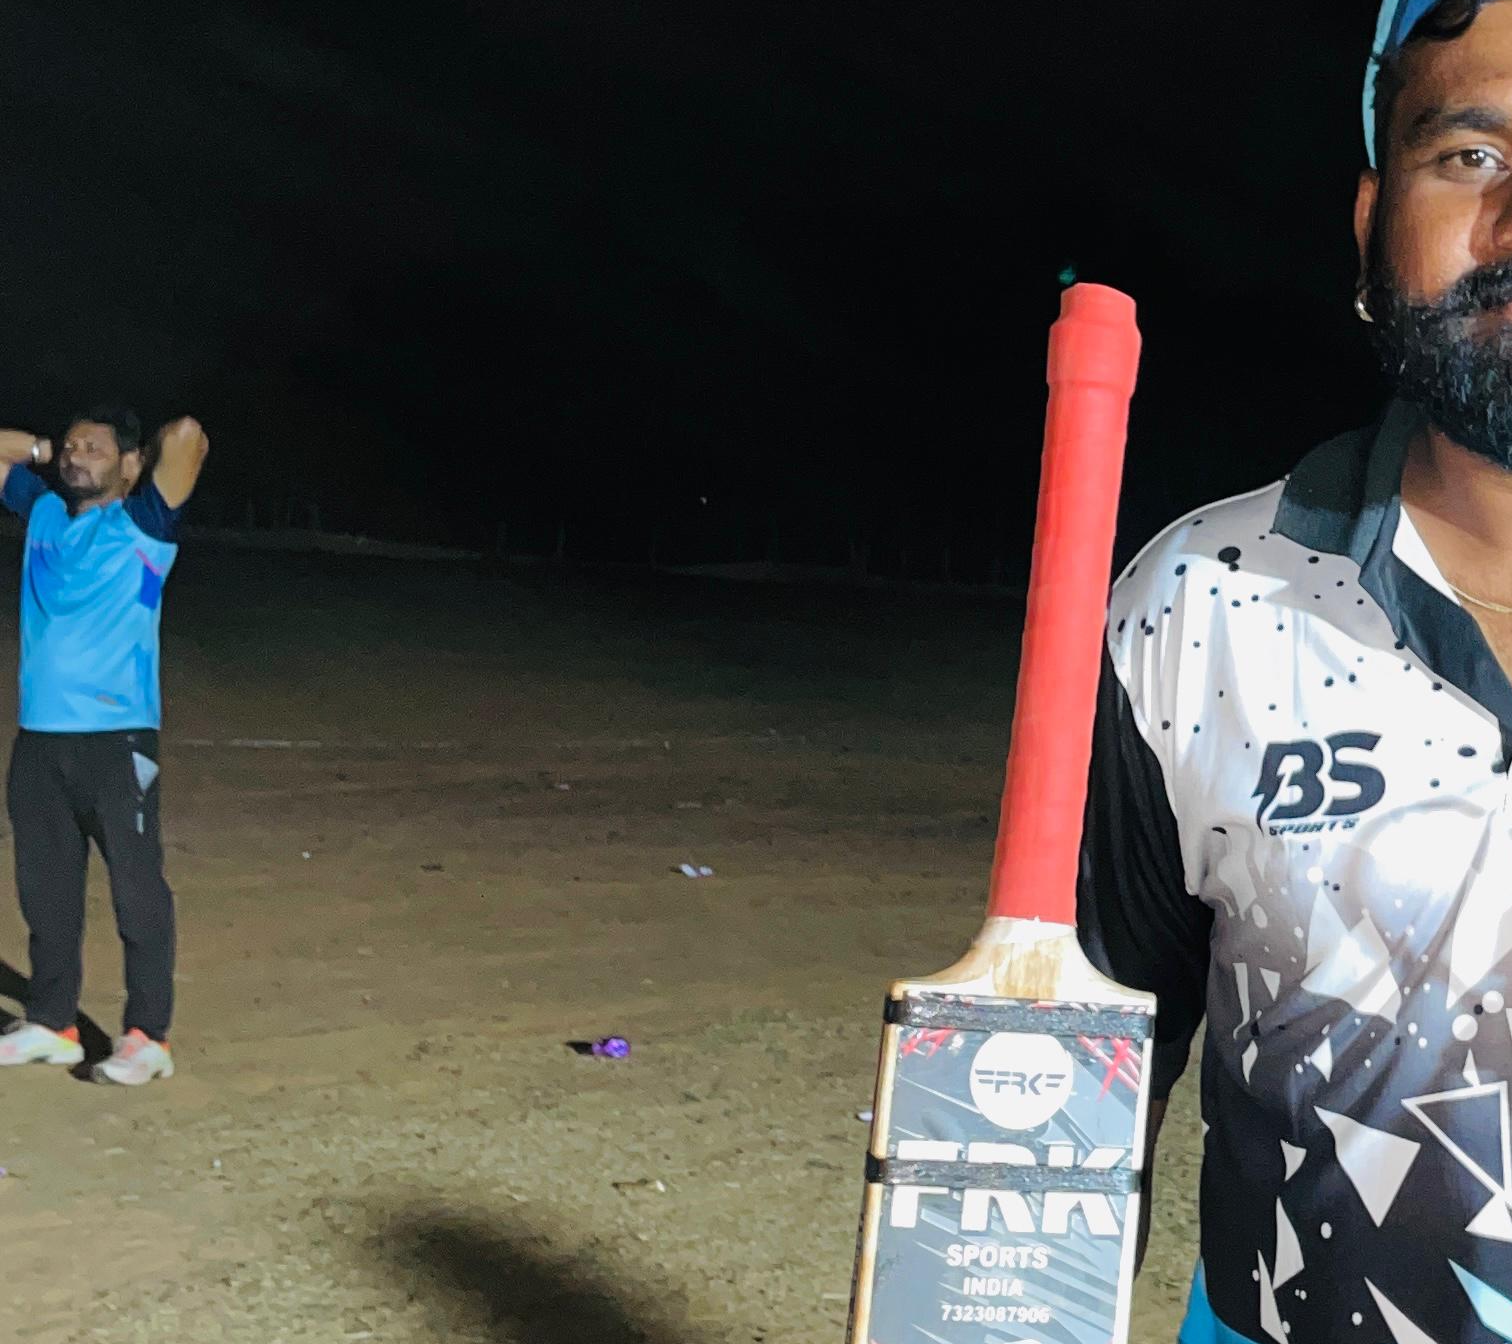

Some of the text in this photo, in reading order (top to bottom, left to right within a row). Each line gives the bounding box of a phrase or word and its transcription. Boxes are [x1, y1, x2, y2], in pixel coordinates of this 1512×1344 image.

[1252, 730, 1386, 836] BS
[946, 1243, 1050, 1270] SPORTS
[962, 1276, 1025, 1297] INDIA
